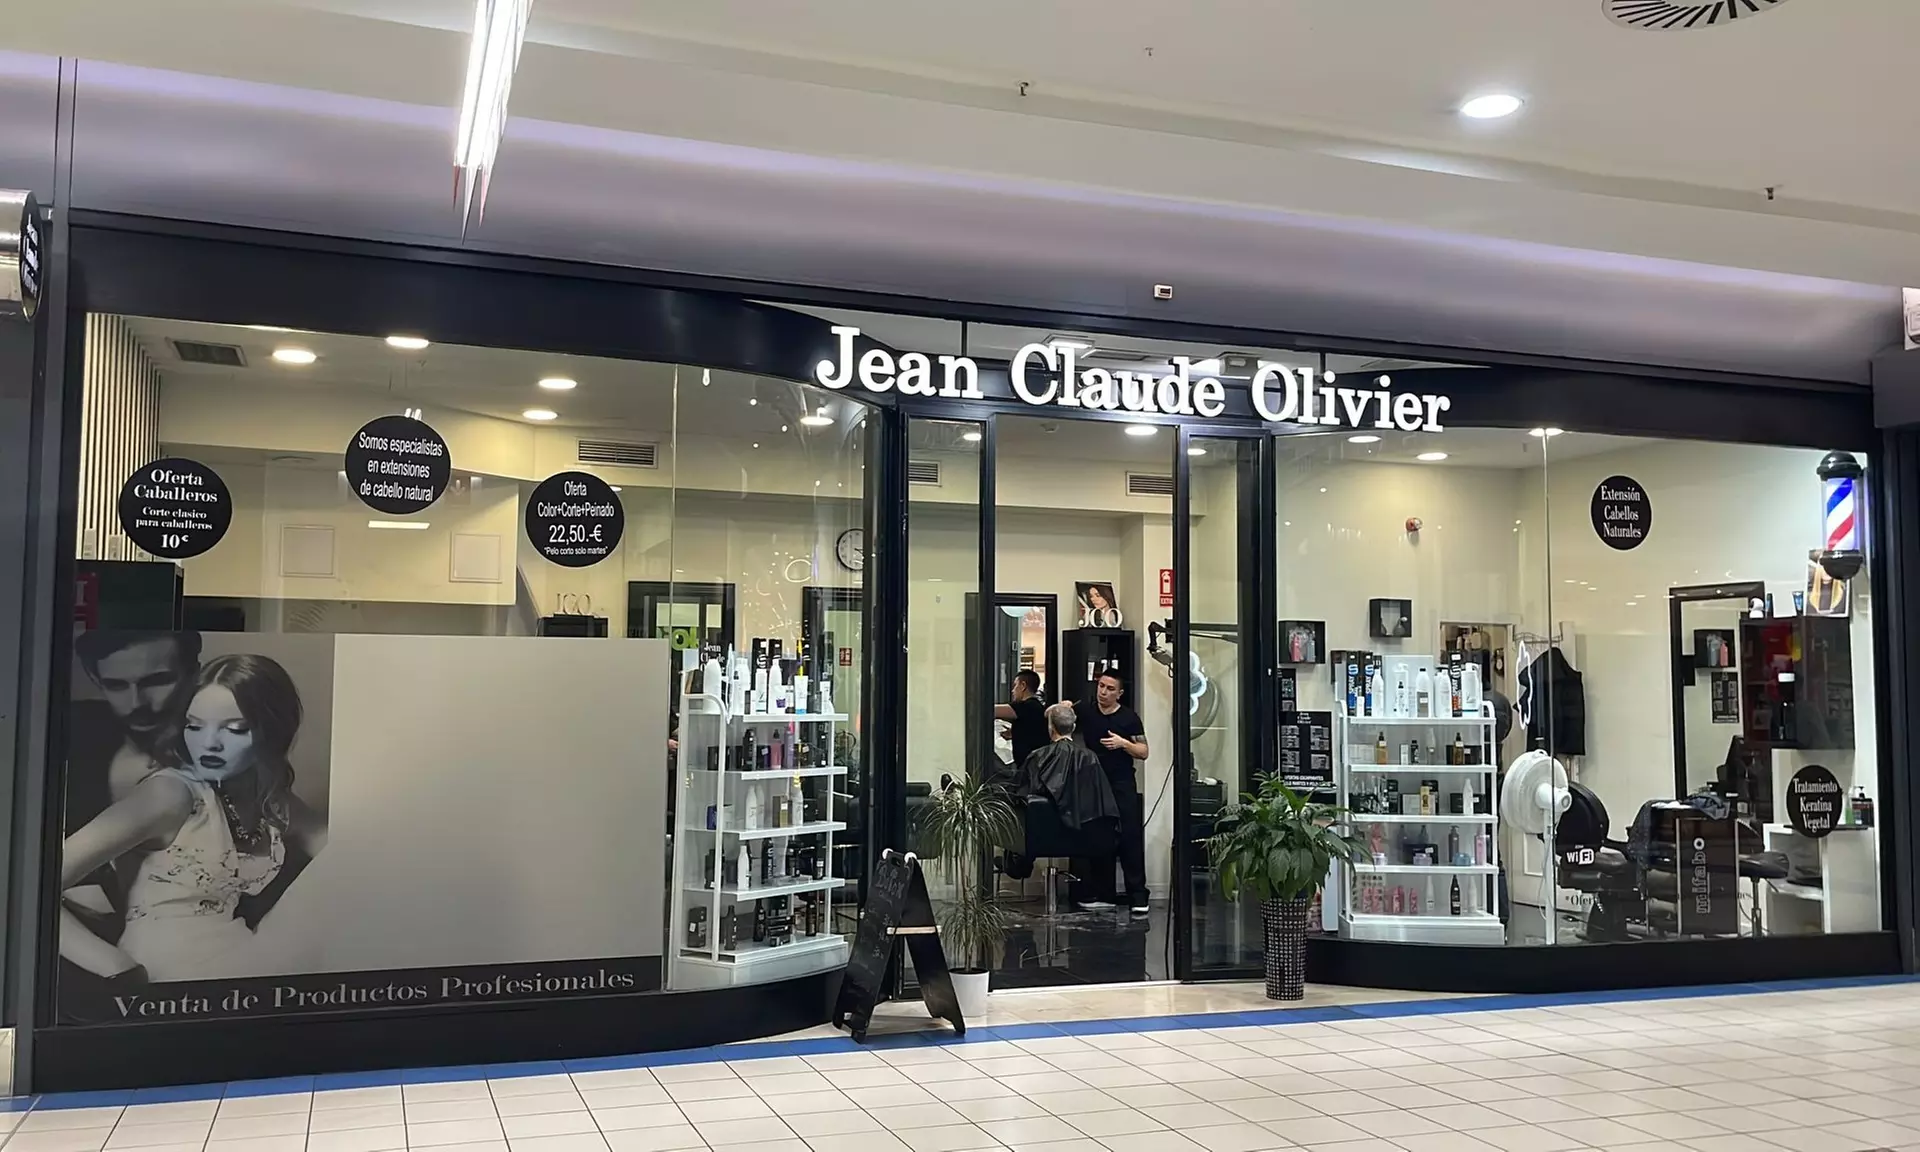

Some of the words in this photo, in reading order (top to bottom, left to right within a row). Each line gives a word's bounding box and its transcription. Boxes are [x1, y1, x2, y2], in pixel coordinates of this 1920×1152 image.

[815, 325, 984, 400] Jean
[1010, 342, 1225, 418] Claude
[1251, 361, 1451, 433] Olivier
[358, 431, 389, 451] Somos
[390, 438, 443, 457] especialistas
[367, 459, 379, 473] en
[380, 459, 430, 478] extensiones
[151, 468, 204, 486] Oferta
[134, 484, 218, 502] Caballeros
[360, 479, 372, 495] de
[373, 480, 403, 498] cabello
[404, 485, 434, 502] natural
[564, 481, 587, 496] Oferta
[1600, 485, 1641, 501] Extensión
[142, 506, 171, 517] Corte
[172, 508, 207, 519] clasico
[537, 502, 615, 517] Color+Corte+Peinado
[1604, 505, 1639, 521] Cabellos
[135, 519, 159, 529] para
[161, 519, 213, 530] caballeros
[1602, 522, 1642, 538] Naturales
[161, 533, 190, 549] 10€
[549, 524, 603, 545] 22,50.-€
[560, 547, 574, 555] corto
[575, 546, 587, 555] solo
[703, 642, 721, 652] Jean
[1793, 778, 1838, 793] Tratamiento
[1800, 796, 1832, 812] Keratina
[1802, 813, 1830, 833] Vegetal
[113, 995, 213, 1018] Venta
[221, 990, 259, 1013] de
[273, 977, 428, 1009] Productos
[440, 968, 636, 999] Profesionales
